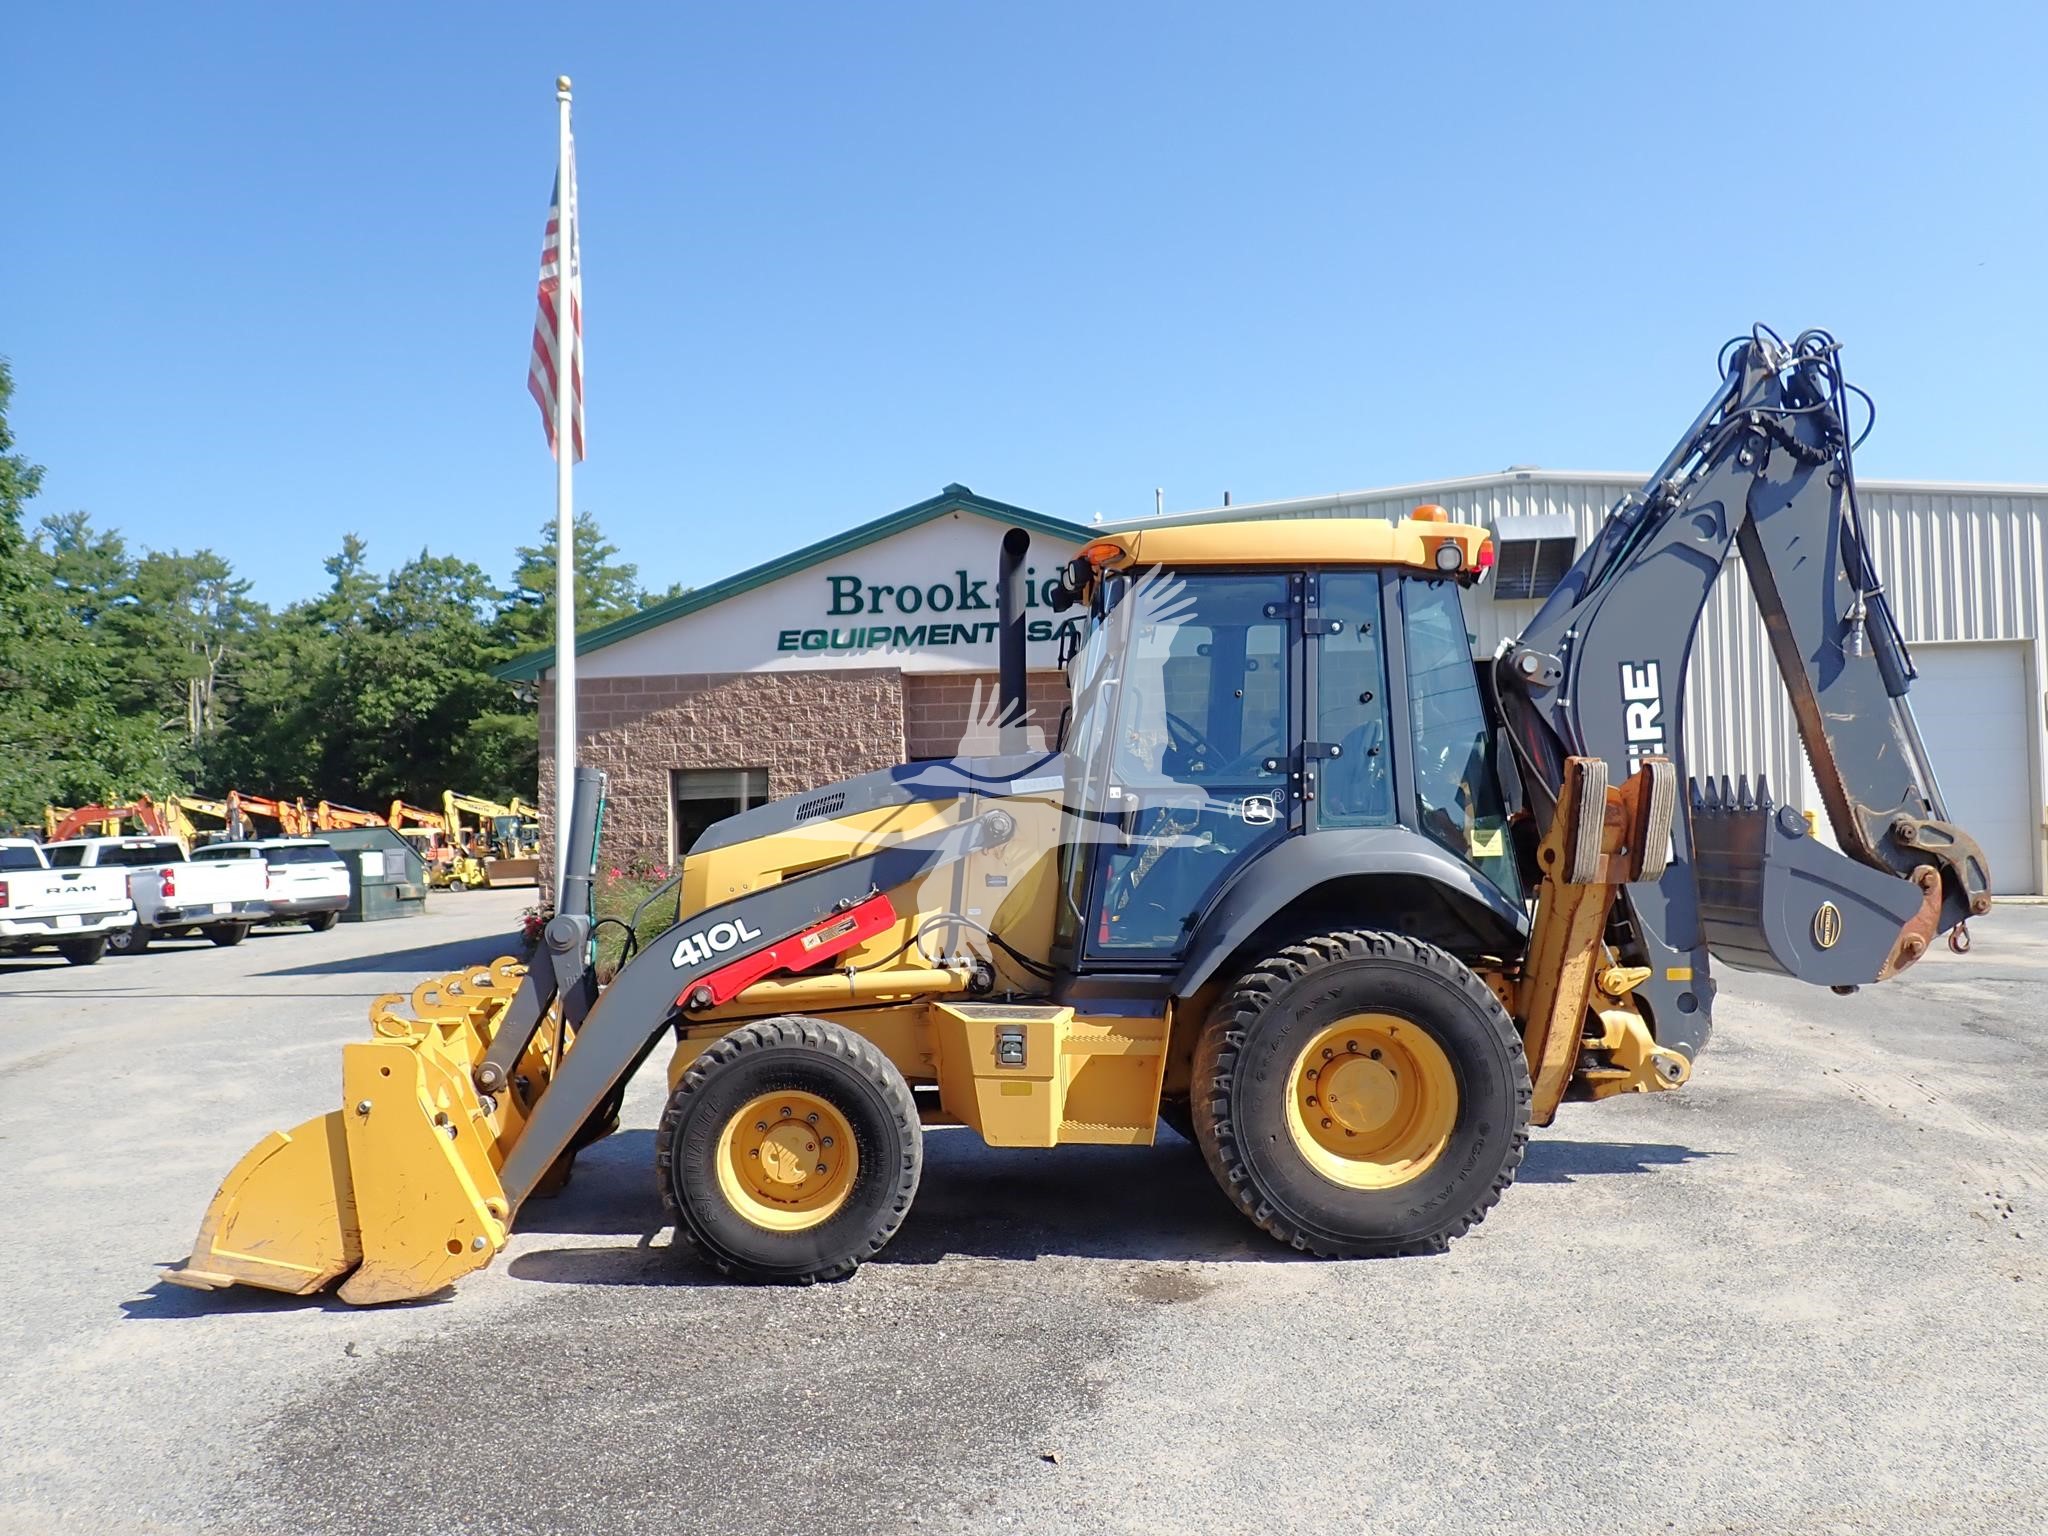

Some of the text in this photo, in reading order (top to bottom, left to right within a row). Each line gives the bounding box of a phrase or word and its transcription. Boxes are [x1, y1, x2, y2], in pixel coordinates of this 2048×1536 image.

[826, 567, 1065, 615] Brookid
[777, 622, 1000, 651] EQUIPMENT
[46, 885, 97, 894] RAM
[670, 917, 762, 970] 410L
